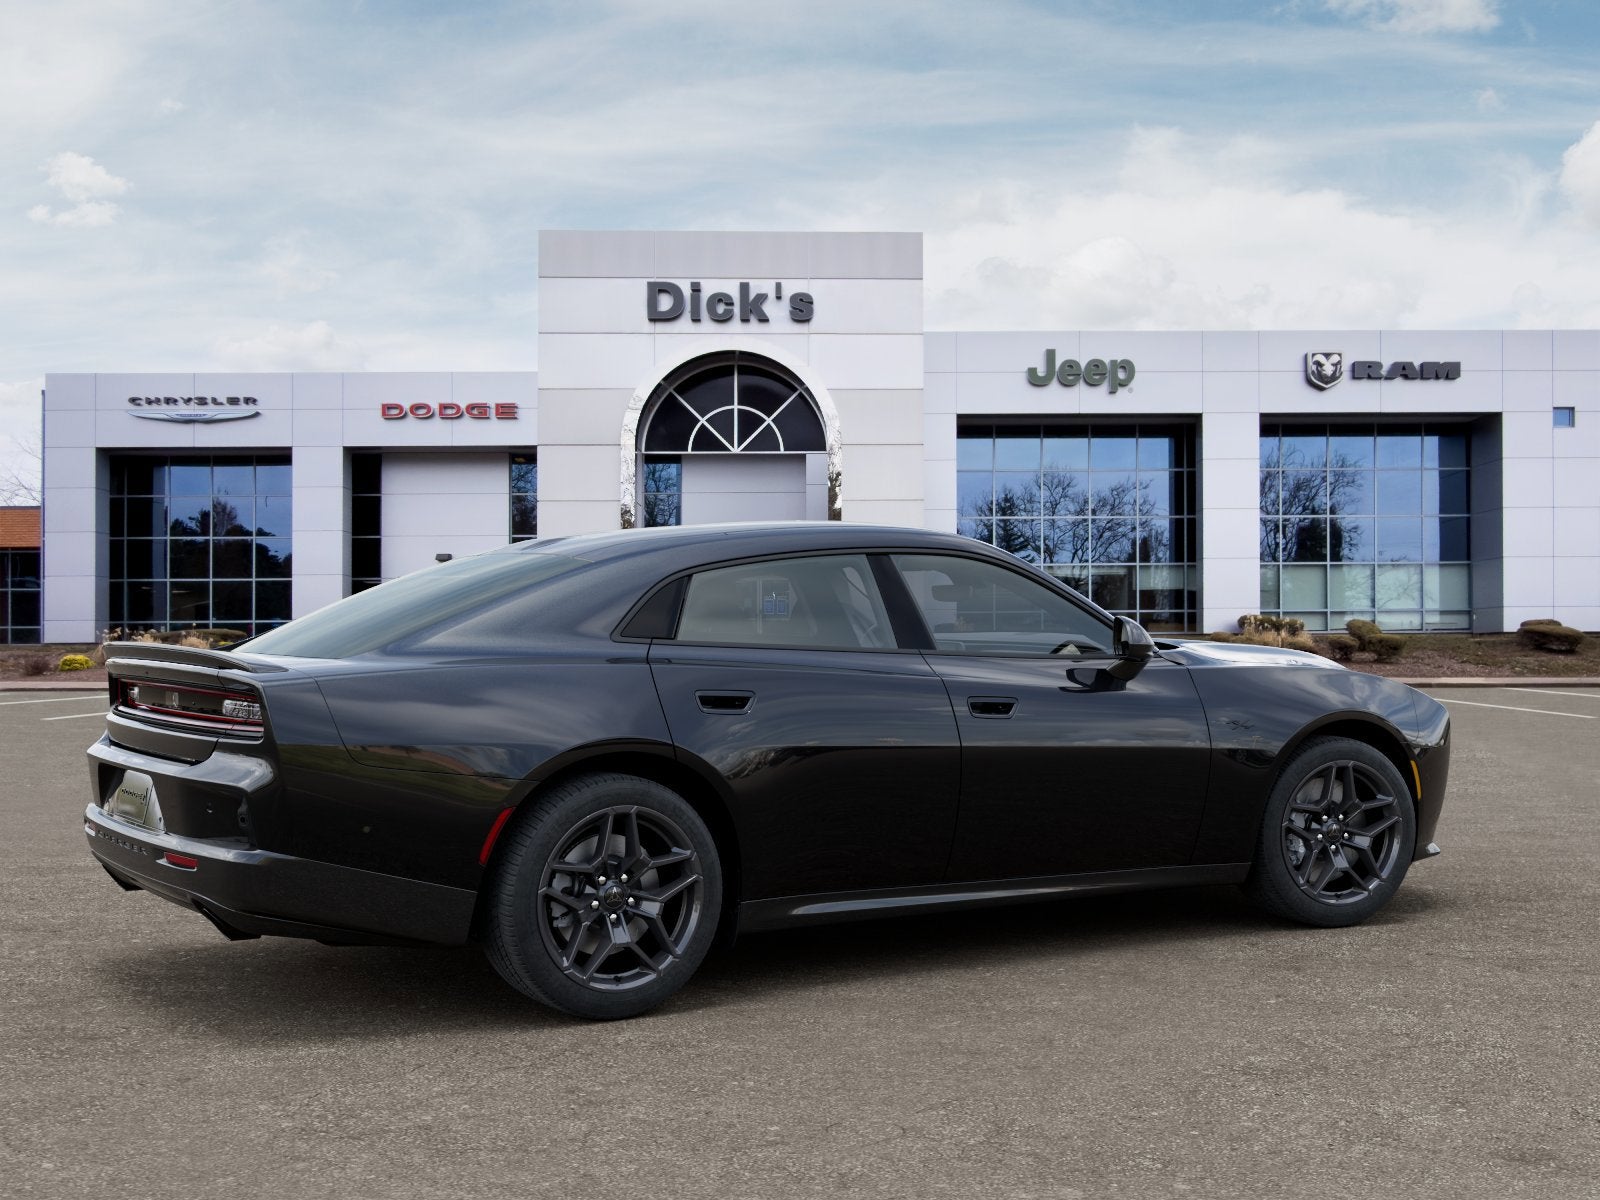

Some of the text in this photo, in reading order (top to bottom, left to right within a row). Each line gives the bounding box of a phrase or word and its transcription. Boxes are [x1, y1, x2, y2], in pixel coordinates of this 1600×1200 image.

[647, 281, 814, 322] Dick's
[1027, 348, 1136, 394] Jeep
[1352, 361, 1462, 380] RAM
[128, 396, 259, 407] CHRYSLER
[381, 402, 519, 419] DODGE
